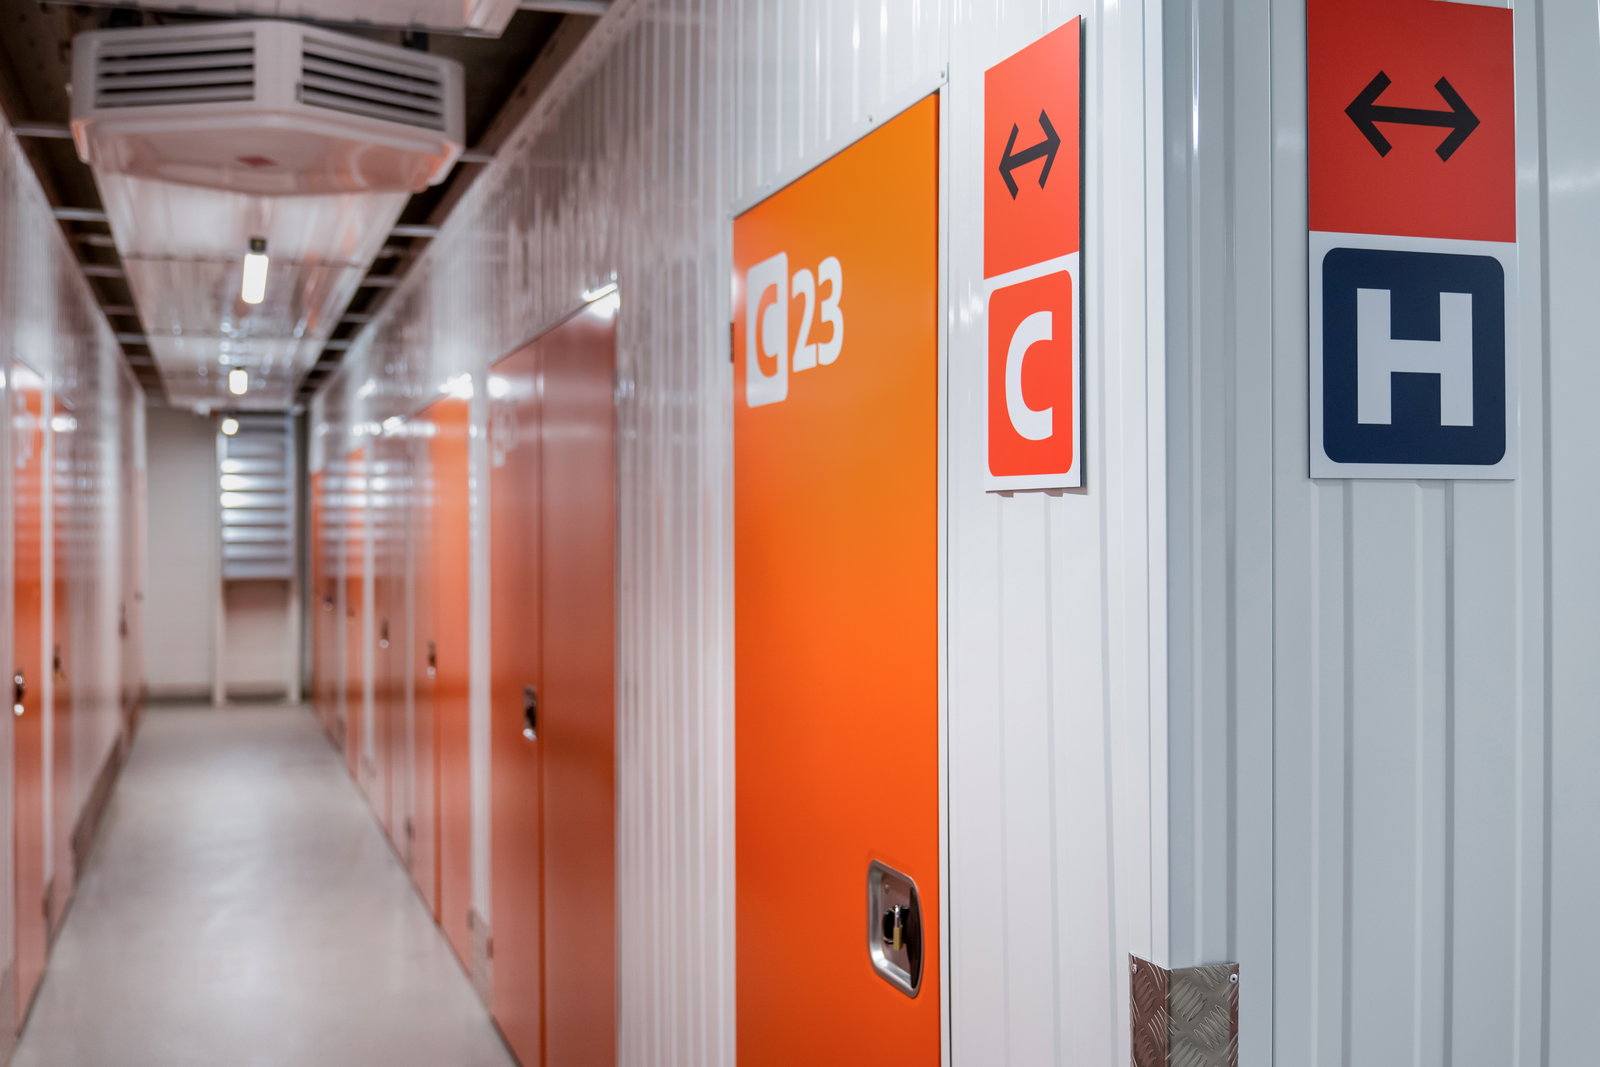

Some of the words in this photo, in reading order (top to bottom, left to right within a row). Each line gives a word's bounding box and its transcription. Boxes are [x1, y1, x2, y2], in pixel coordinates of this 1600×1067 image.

[792, 256, 844, 373] 23
[1005, 311, 1053, 441] C
[1357, 288, 1474, 427] H
